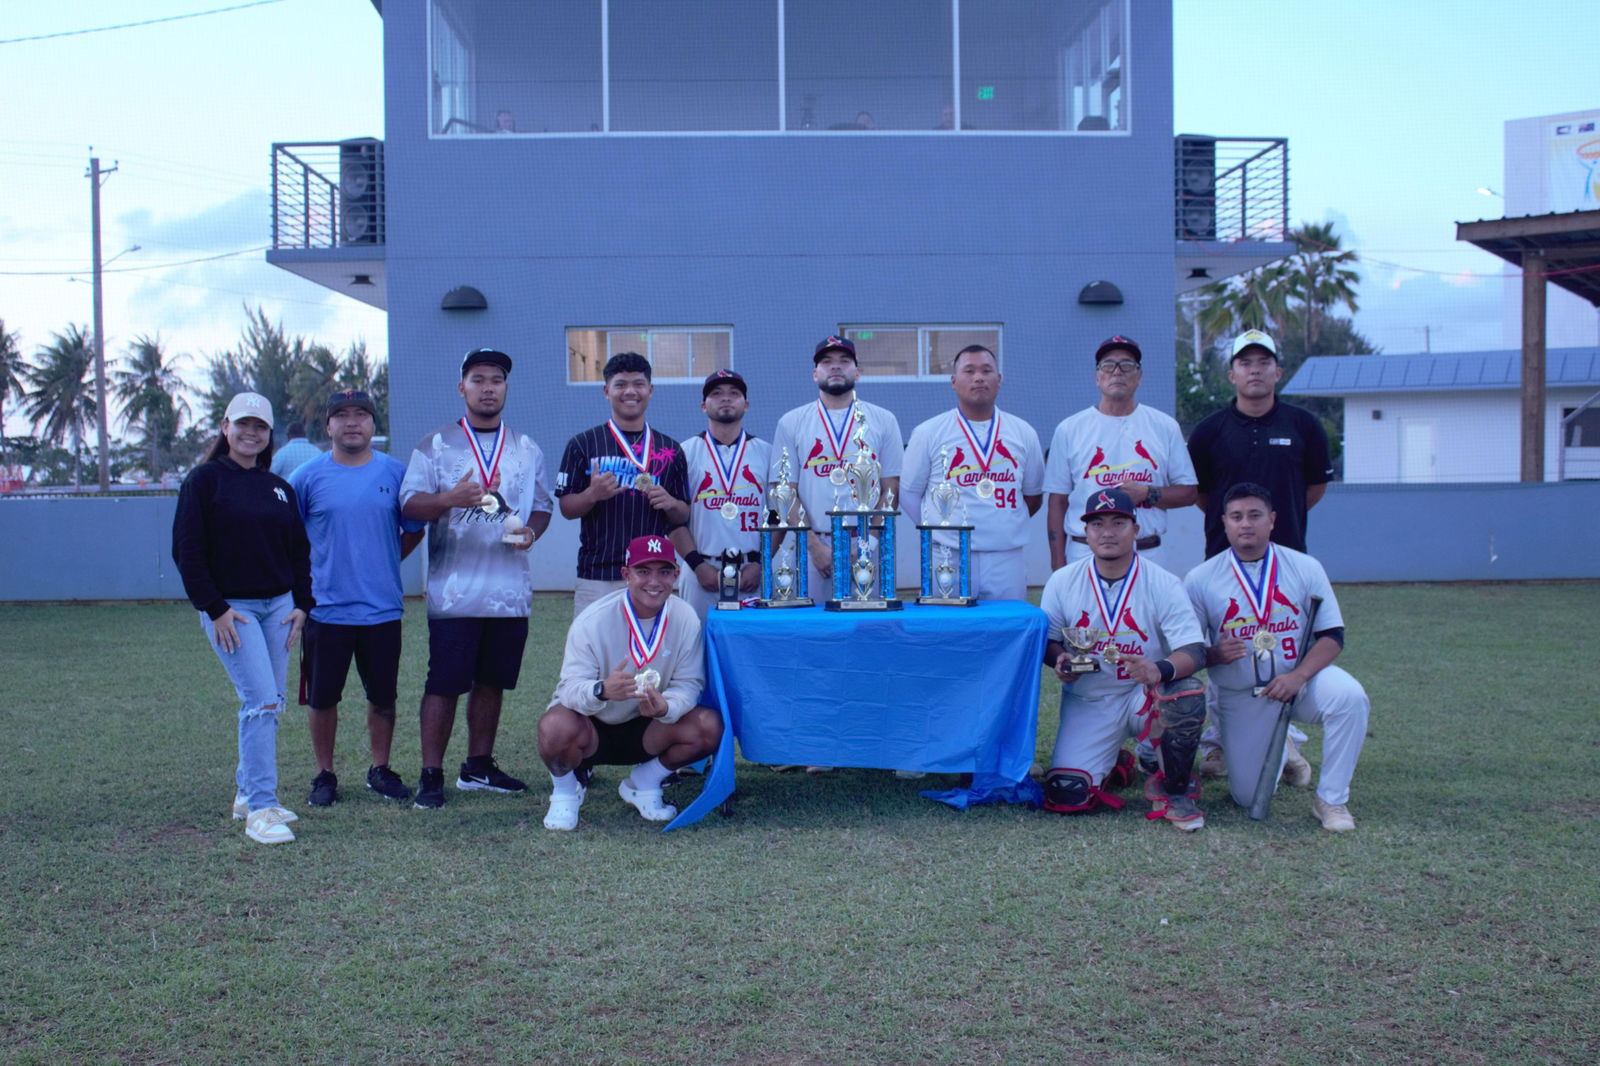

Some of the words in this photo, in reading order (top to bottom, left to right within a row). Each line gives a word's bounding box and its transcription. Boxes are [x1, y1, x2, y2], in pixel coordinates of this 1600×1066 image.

[956, 464, 1017, 487] Carinals
[1095, 464, 1153, 487] Cardinals
[994, 488, 1017, 509] 94
[740, 511, 759, 532] 13
[647, 539, 662, 553] NY
[1231, 616, 1299, 641] Carnals
[1281, 637, 1297, 660] 9
